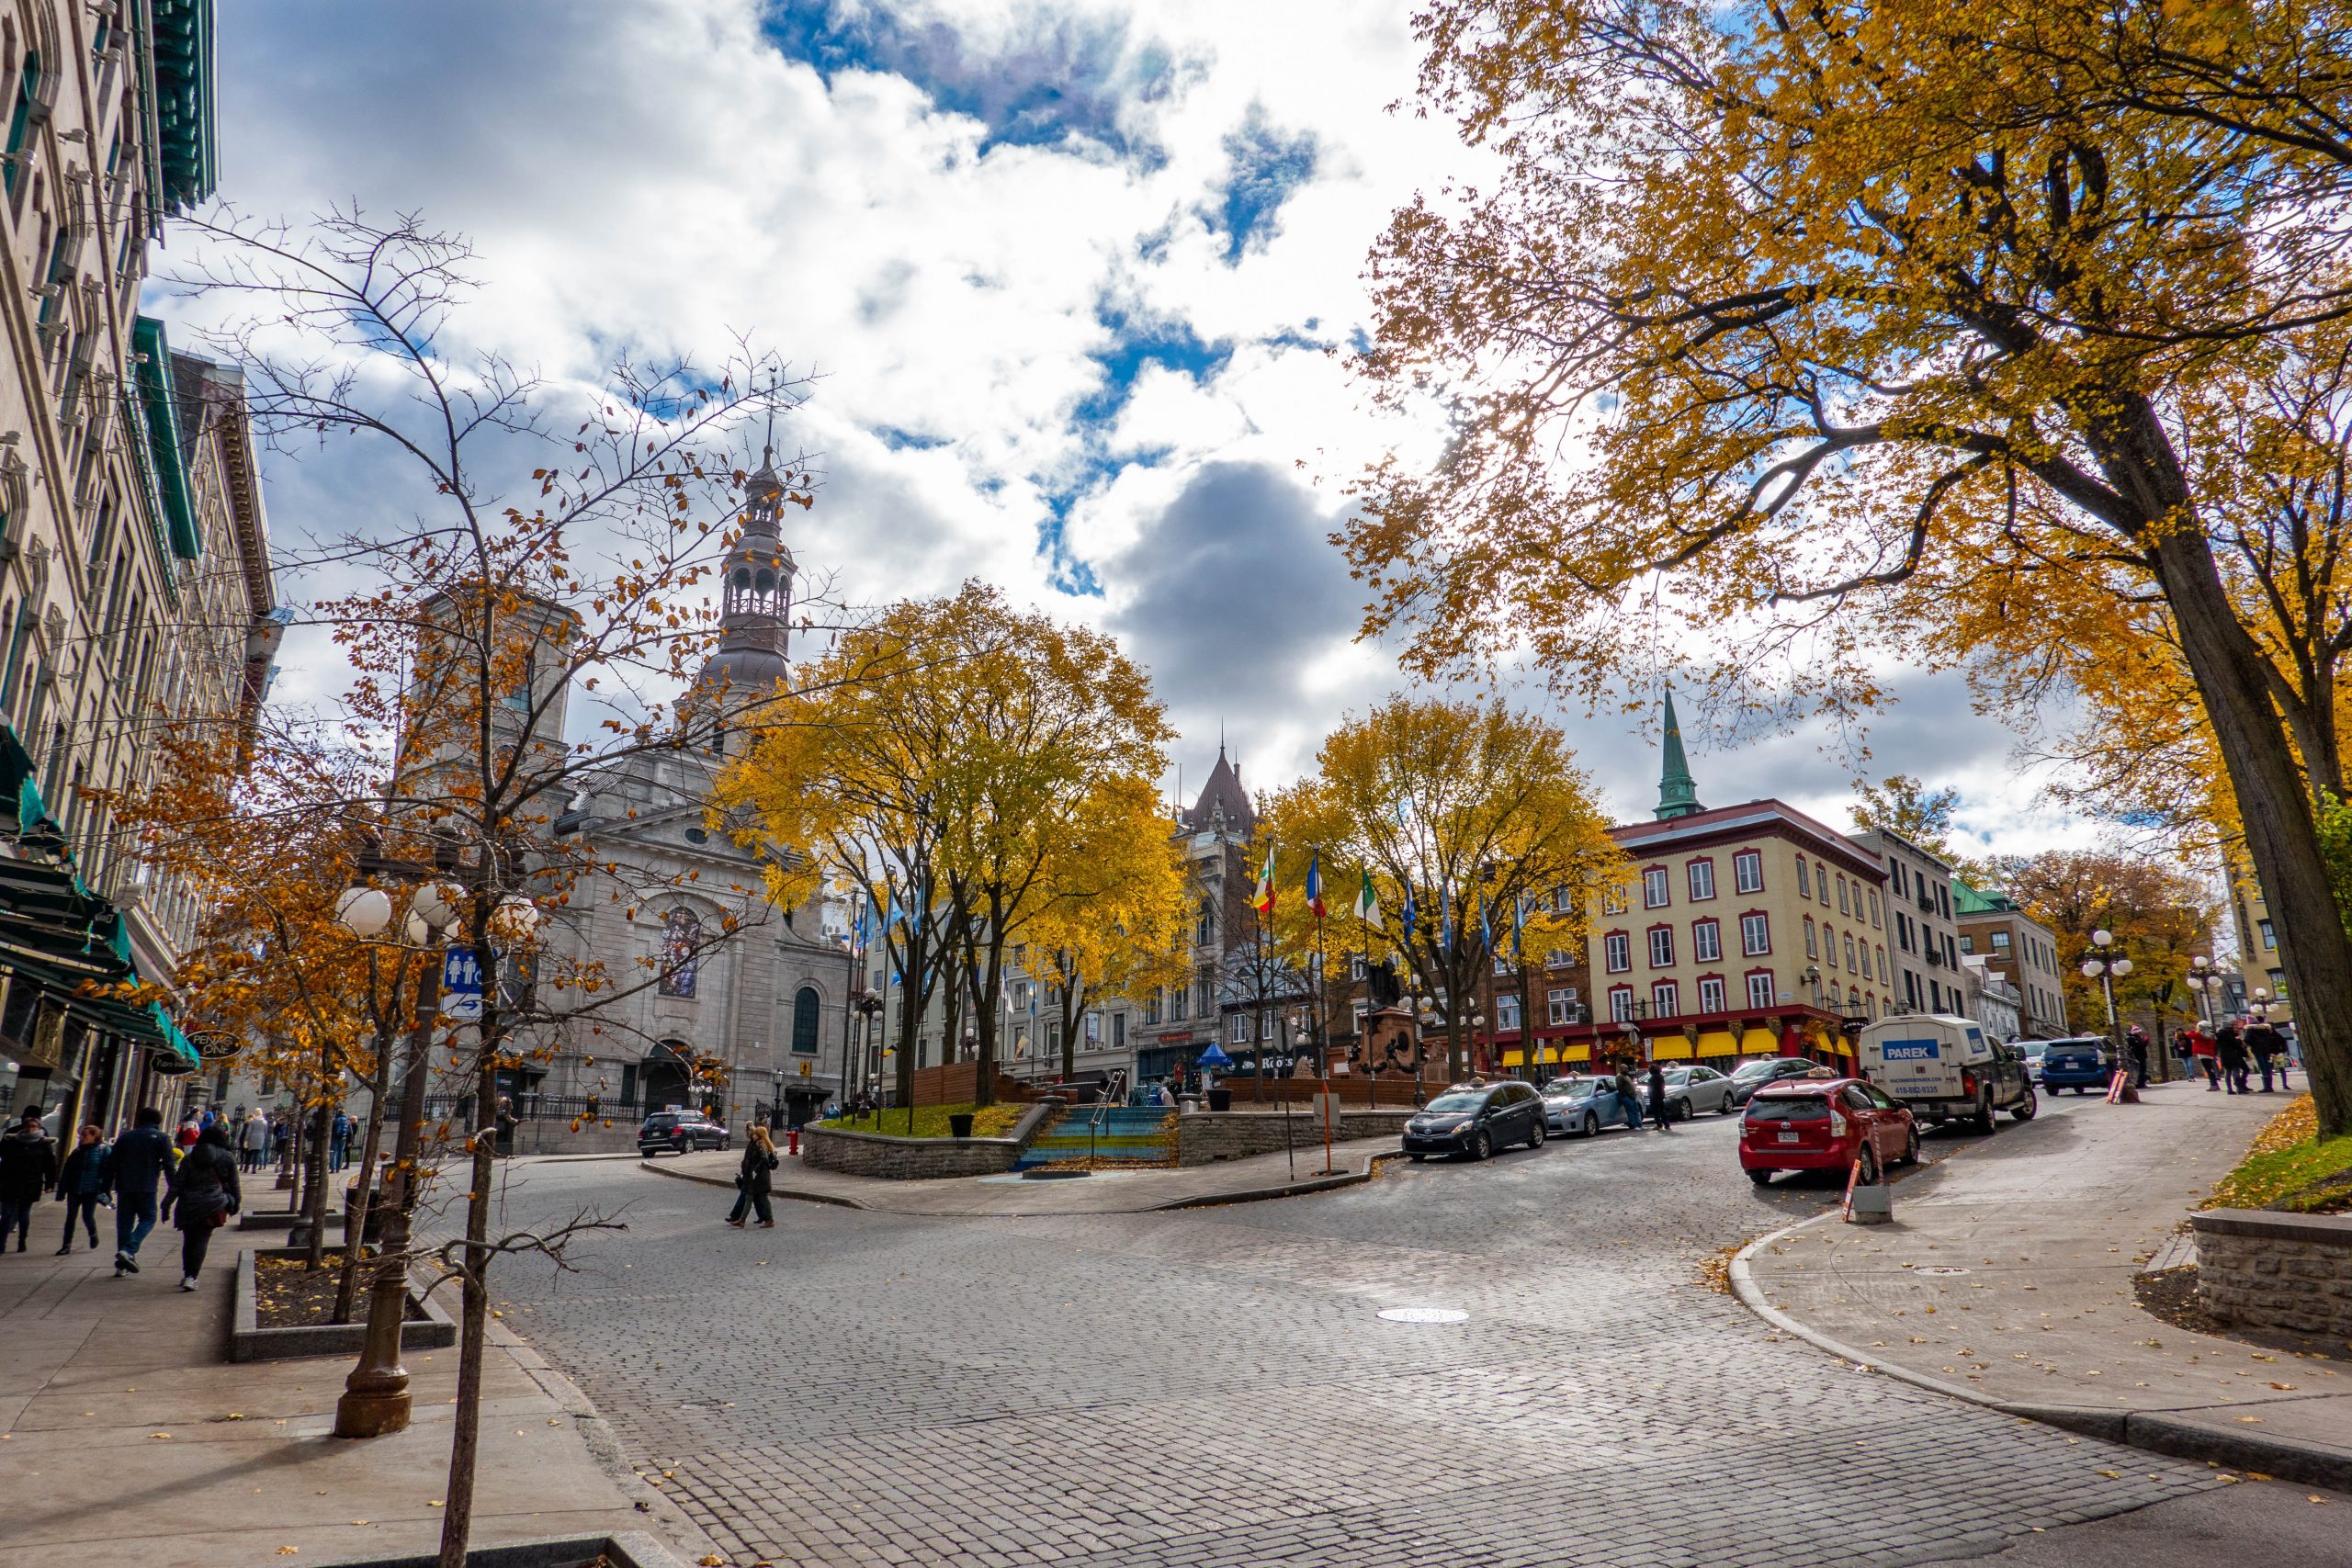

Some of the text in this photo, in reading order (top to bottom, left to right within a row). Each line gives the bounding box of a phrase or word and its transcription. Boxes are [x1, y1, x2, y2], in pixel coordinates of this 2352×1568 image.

[203, 1044, 229, 1055] ONE
[1887, 1047, 1929, 1058] PAREK
[1895, 1086, 1939, 1094] 418-882-9335
